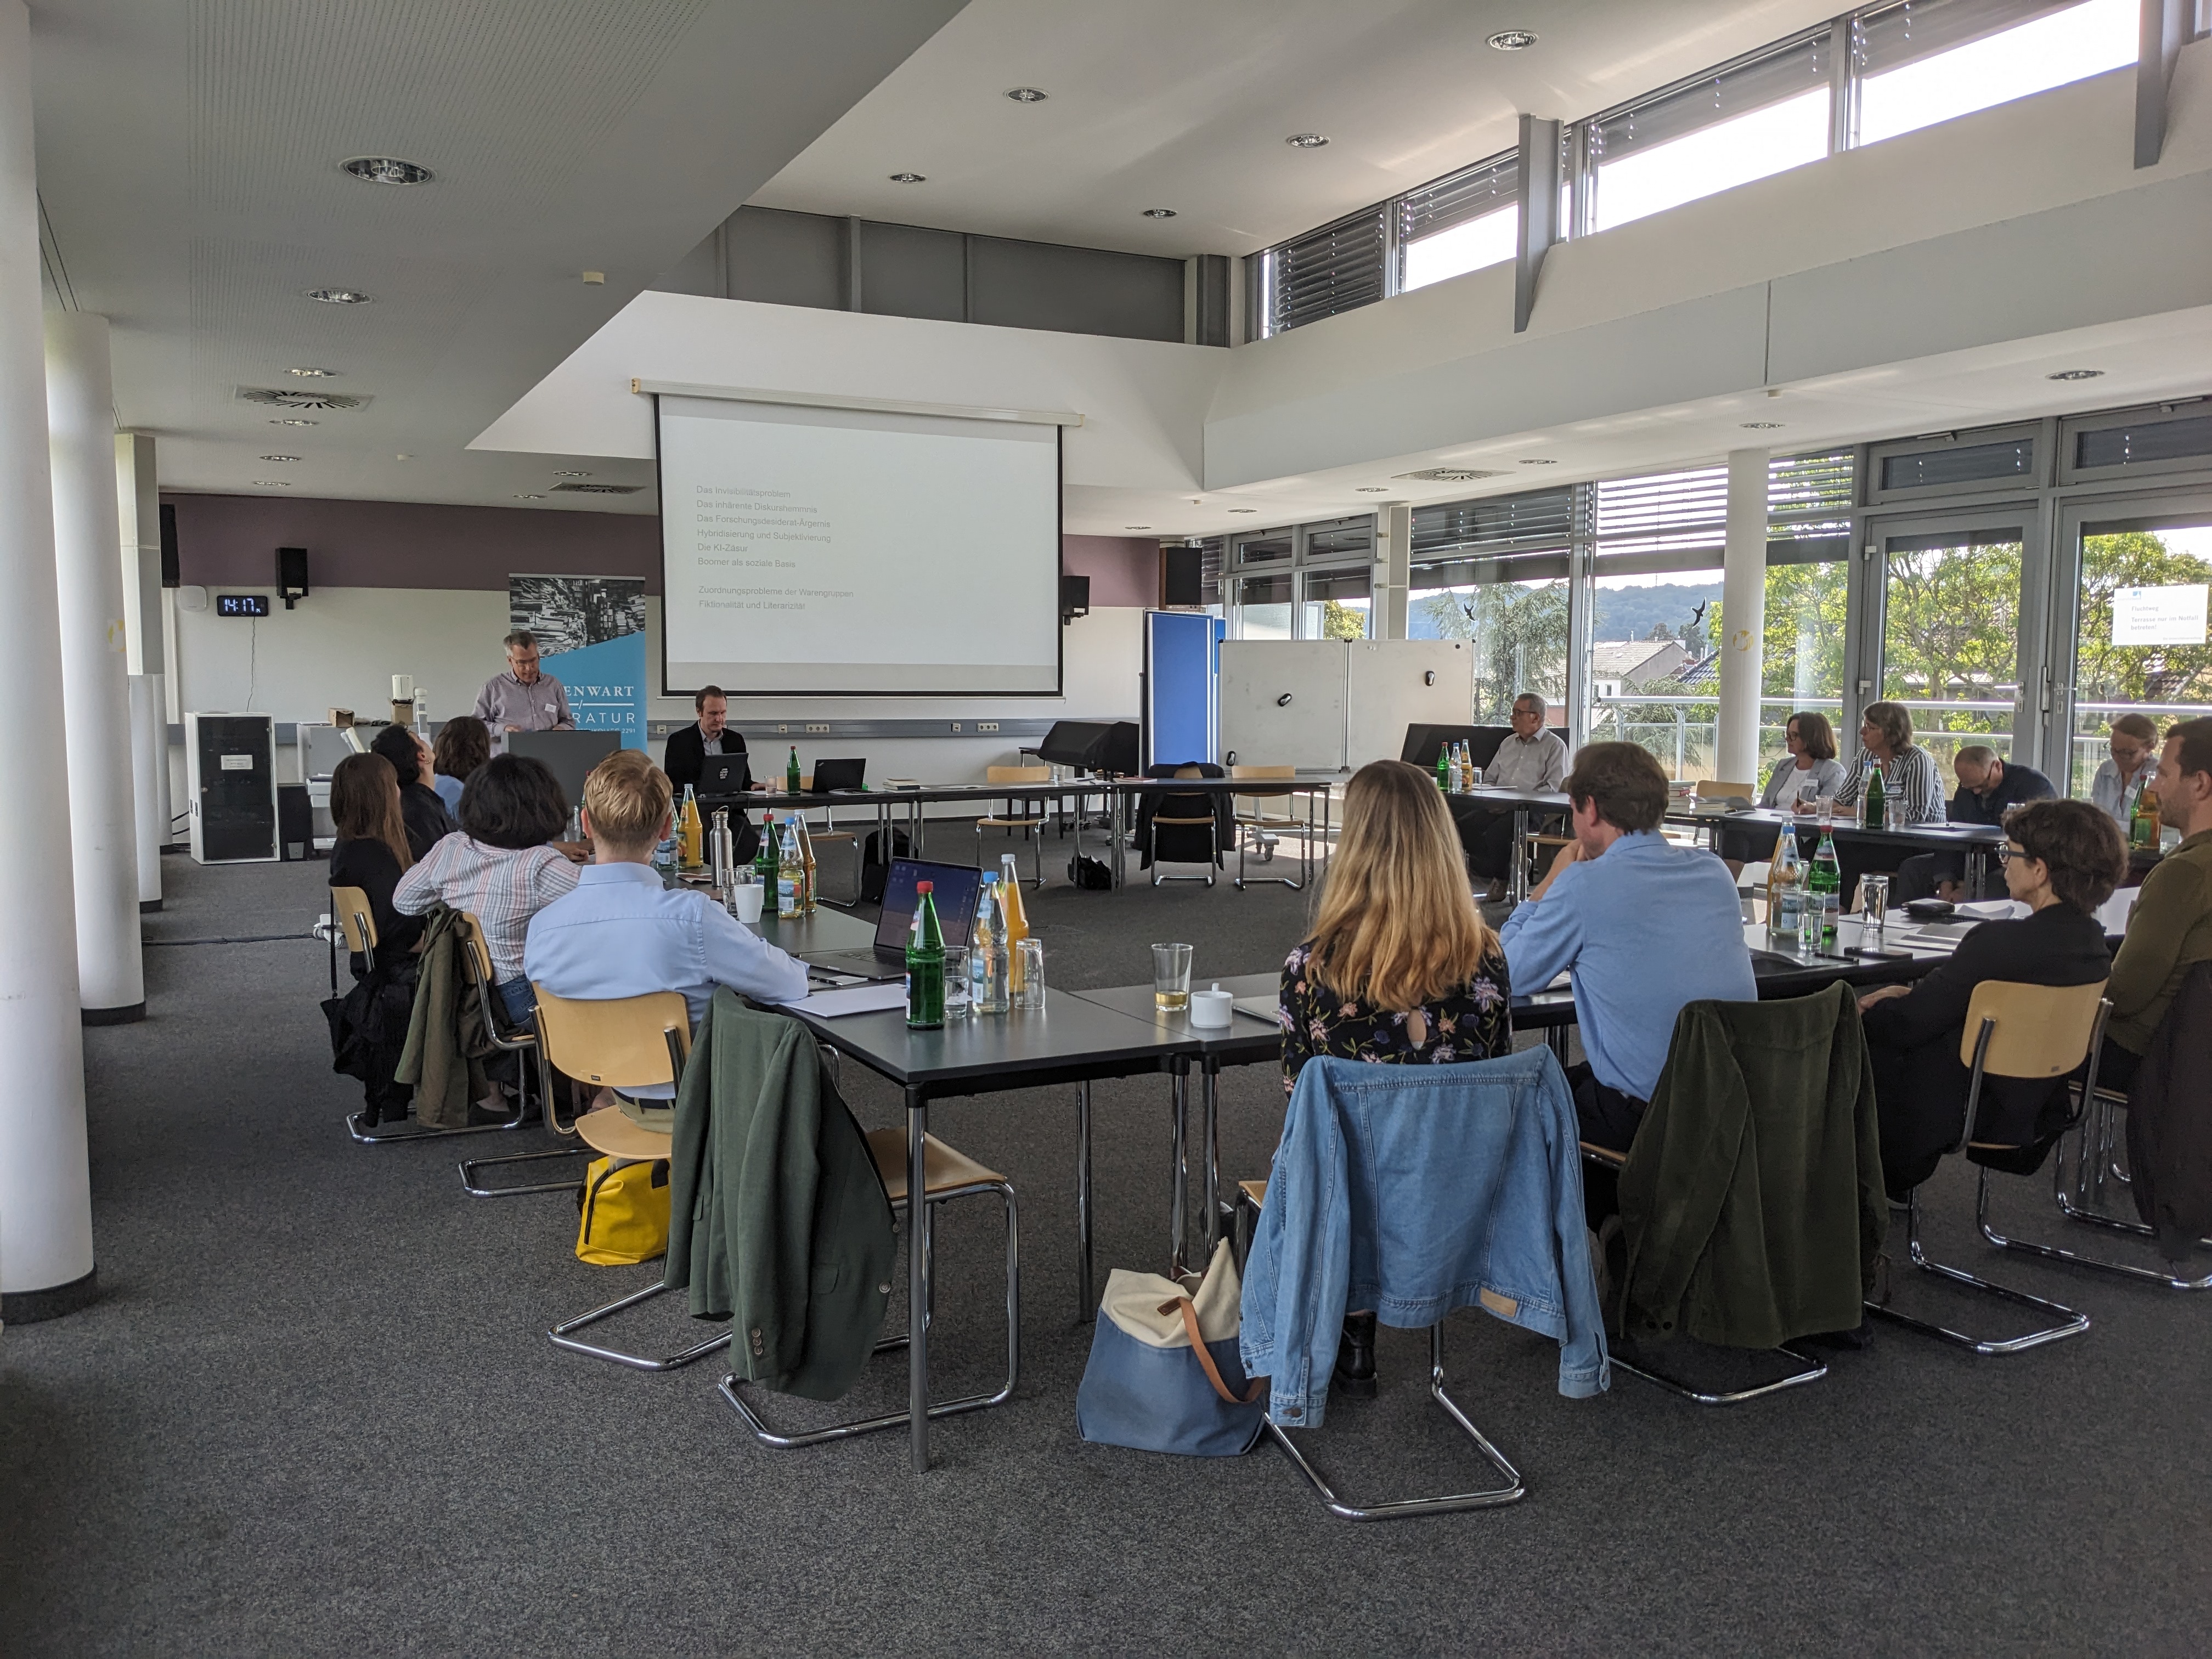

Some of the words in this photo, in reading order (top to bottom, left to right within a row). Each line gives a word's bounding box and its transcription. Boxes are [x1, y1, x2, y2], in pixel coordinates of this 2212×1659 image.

[696, 485, 713, 494] Das
[696, 500, 713, 509] Das
[754, 503, 817, 514] Diskurshemmnis
[697, 514, 713, 523] Das
[715, 515, 831, 528] Forschungsdesiderat-Ärgernis
[697, 529, 754, 540] Hybridisierung
[773, 532, 831, 543] Subjektivierung
[698, 543, 711, 551] Die
[697, 557, 729, 566] Boomer
[732, 558, 743, 567] als
[746, 559, 773, 567] soziale
[775, 560, 795, 568] Basis
[698, 585, 783, 596] Zuordnungsprobleme
[799, 588, 854, 598] Warengruppen
[224, 598, 255, 612] 14:17
[699, 600, 744, 609] Fiktionalität
[564, 686, 634, 696] ENWART
[572, 713, 635, 724] RATUR
